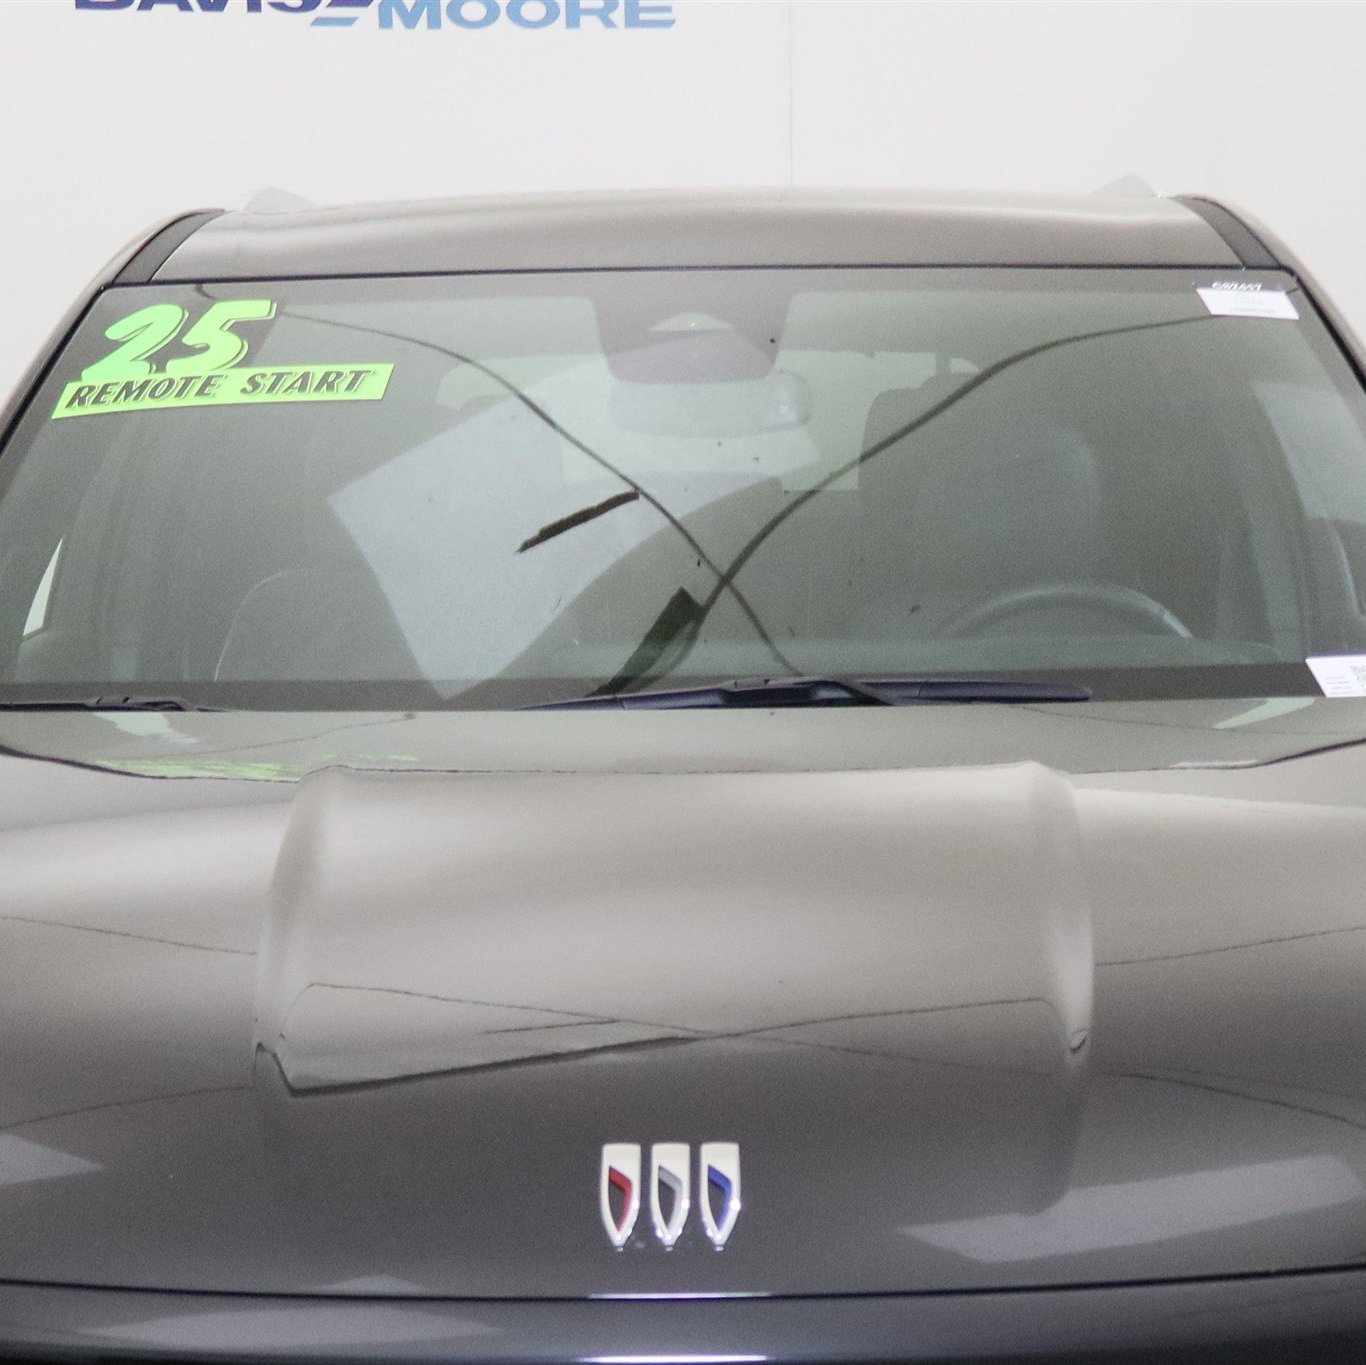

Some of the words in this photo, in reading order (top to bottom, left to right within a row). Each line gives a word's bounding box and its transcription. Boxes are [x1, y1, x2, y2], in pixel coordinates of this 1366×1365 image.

[378, 0, 676, 29] MOORE
[82, 299, 279, 382] 25
[65, 374, 228, 410] REMOTE
[240, 369, 376, 397] START
